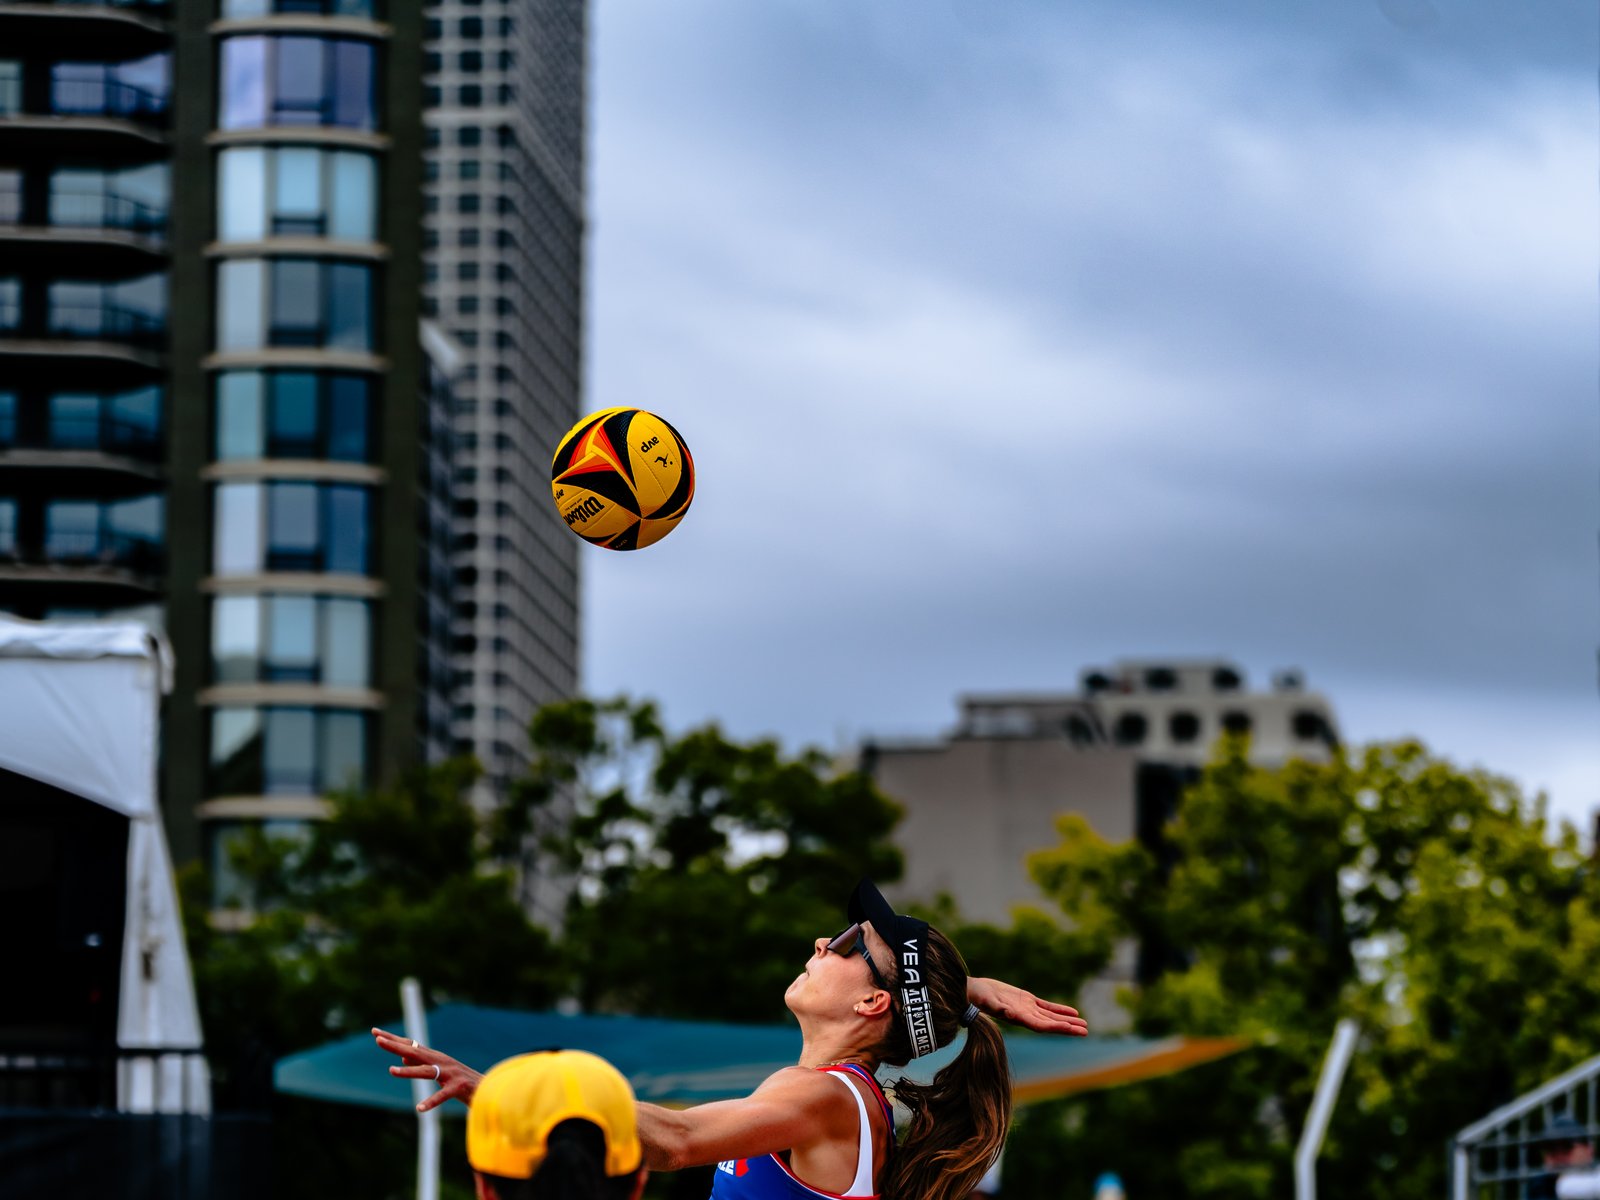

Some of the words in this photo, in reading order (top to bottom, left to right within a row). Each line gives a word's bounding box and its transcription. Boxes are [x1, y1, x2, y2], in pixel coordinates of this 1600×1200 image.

[641, 436, 660, 453] avp
[564, 496, 605, 526] Wilson
[903, 939, 921, 984] VEA
